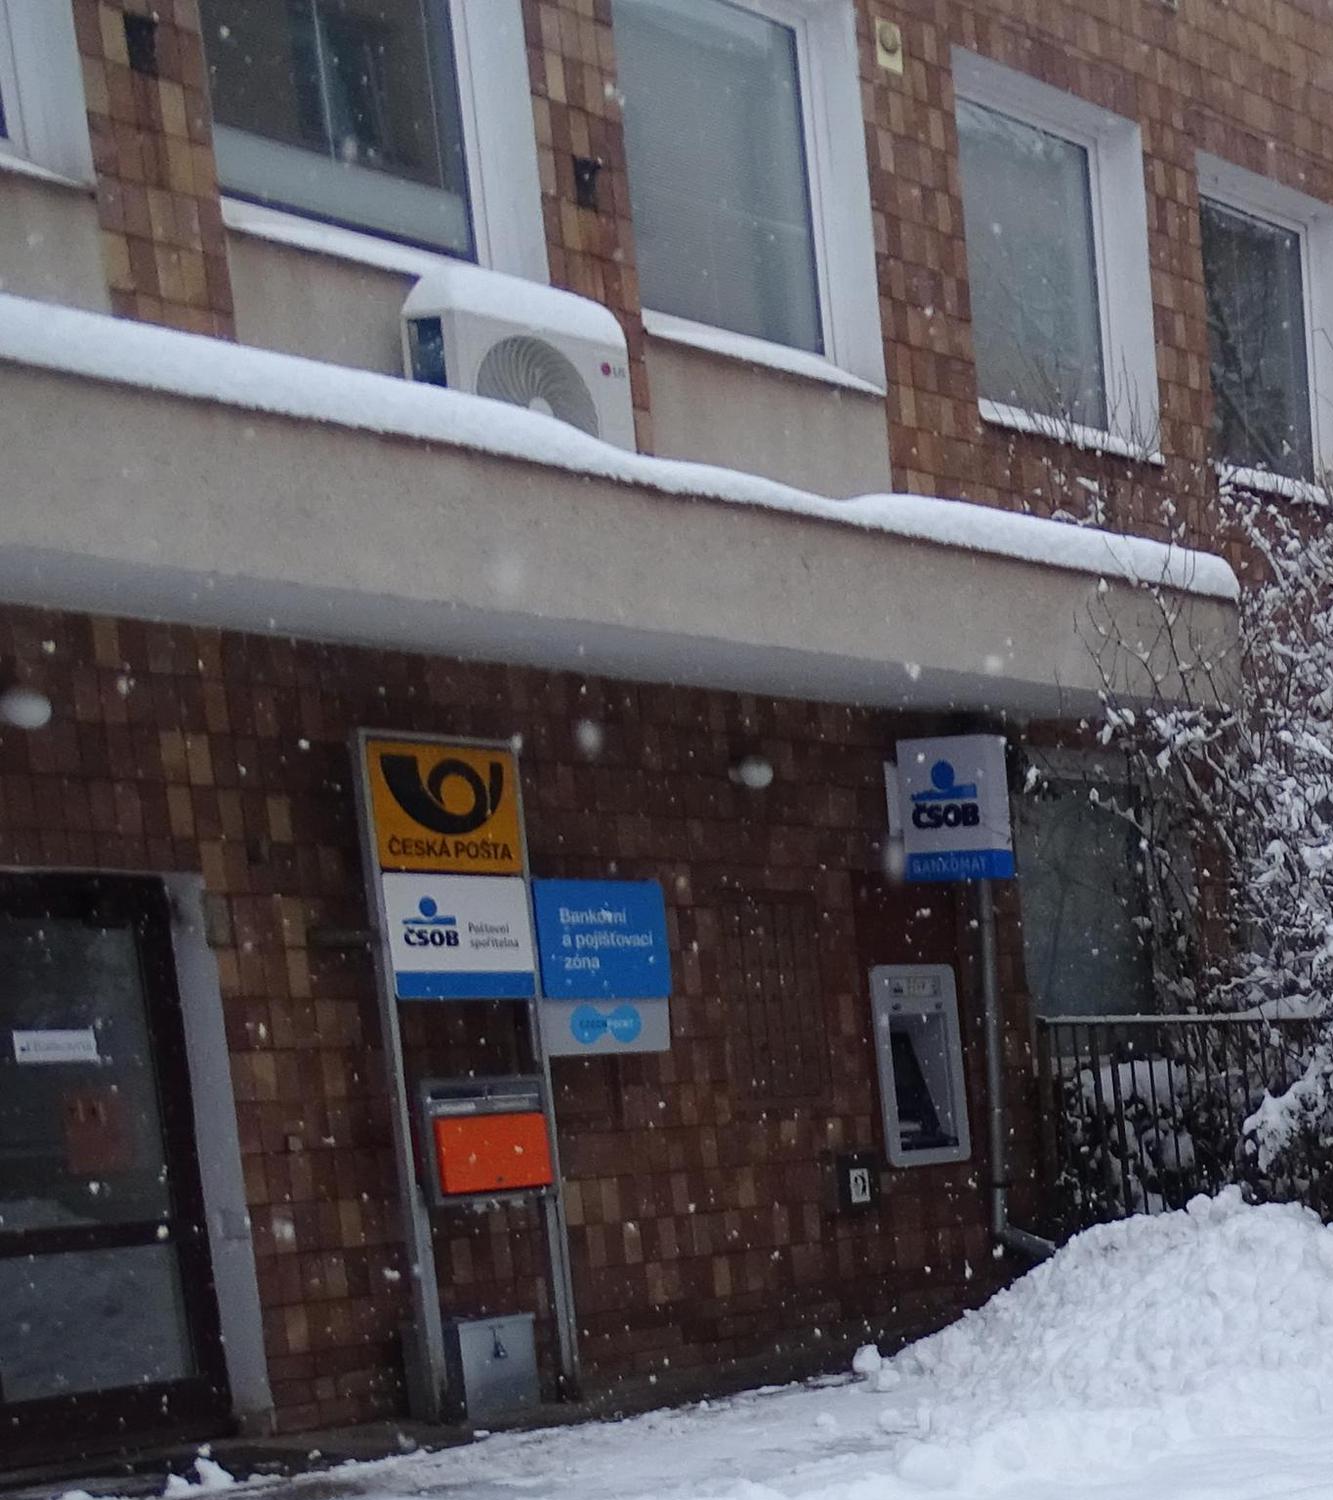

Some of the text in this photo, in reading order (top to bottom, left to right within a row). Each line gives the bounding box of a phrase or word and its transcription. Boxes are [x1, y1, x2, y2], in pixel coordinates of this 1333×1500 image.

[911, 803, 980, 829] ČSOB
[388, 834, 513, 861] ČESKÁ POŠTA
[912, 857, 987, 874] BANKOMAT
[559, 907, 627, 924] Bankovní
[403, 926, 460, 948] ČSOB
[562, 934, 572, 947] a
[575, 930, 654, 951] pojišťovací
[564, 953, 600, 970] zóna
